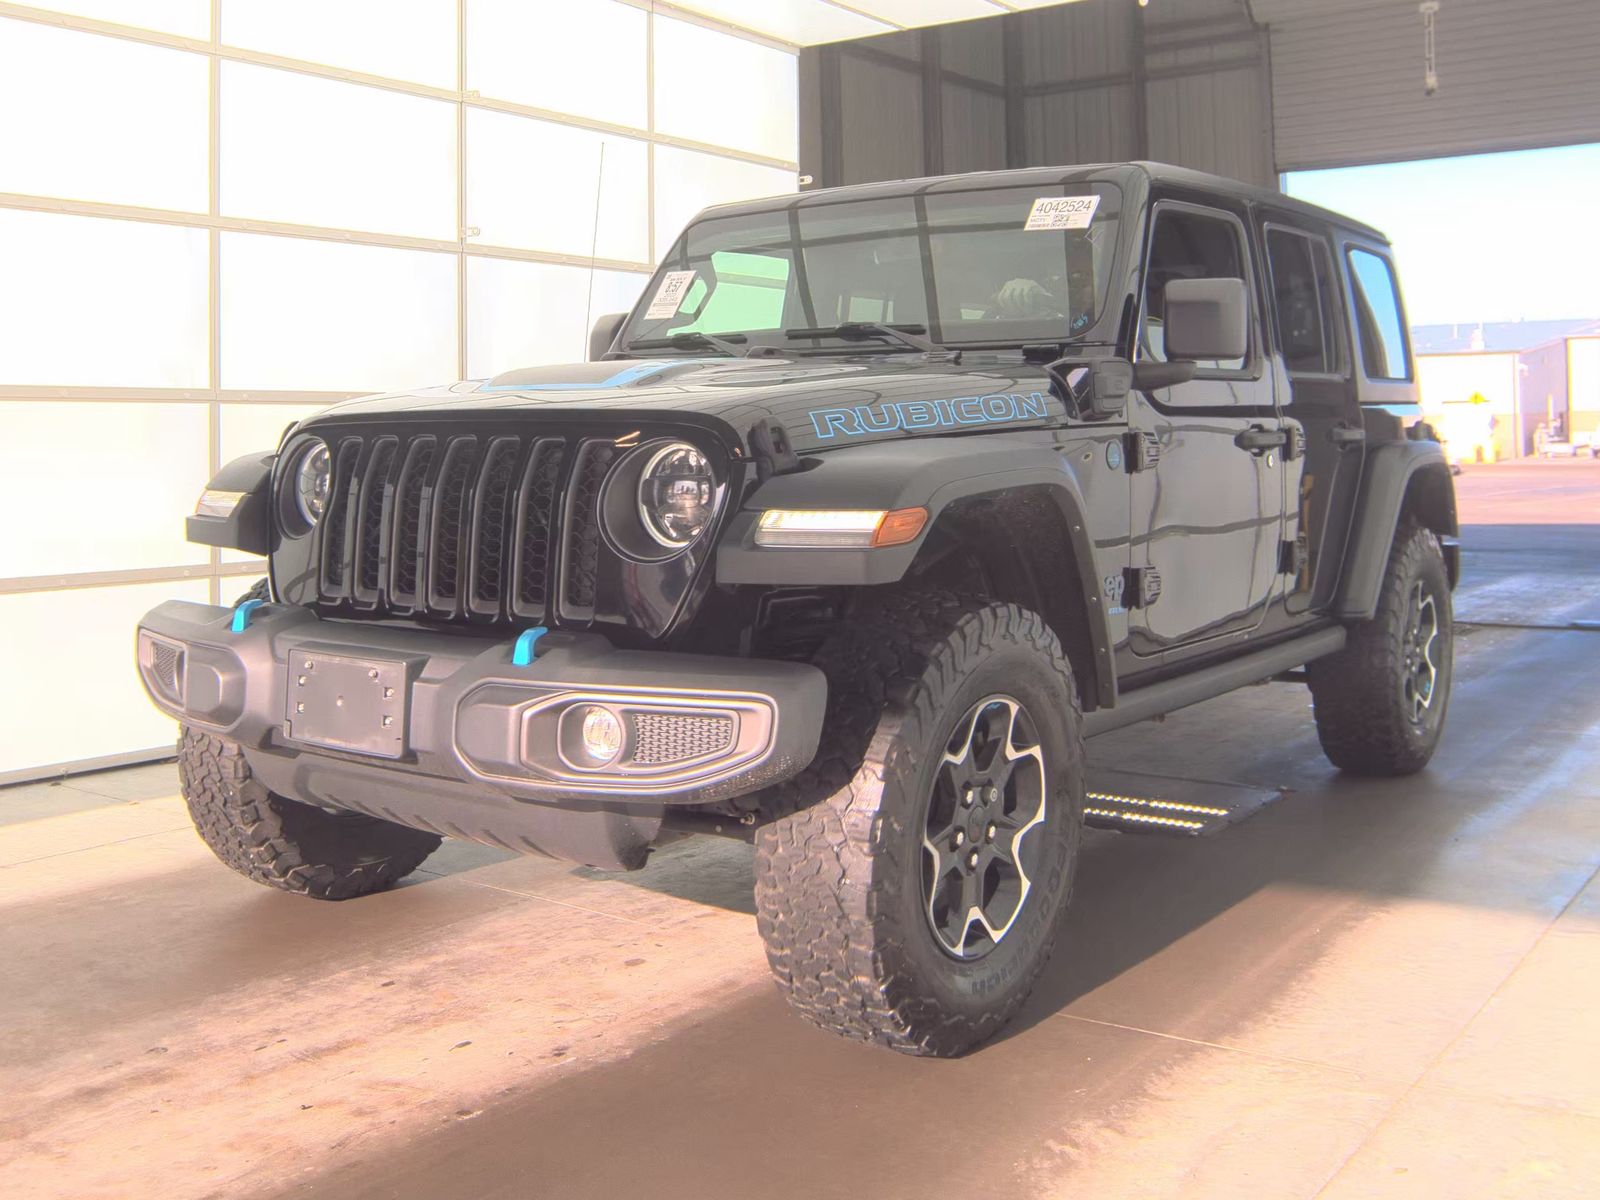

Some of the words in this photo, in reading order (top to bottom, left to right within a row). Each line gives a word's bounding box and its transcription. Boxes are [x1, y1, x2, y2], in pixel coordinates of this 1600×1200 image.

[1036, 200, 1092, 214] 4042524
[809, 392, 1048, 438] RUBICON
[1103, 575, 1125, 602] ep
